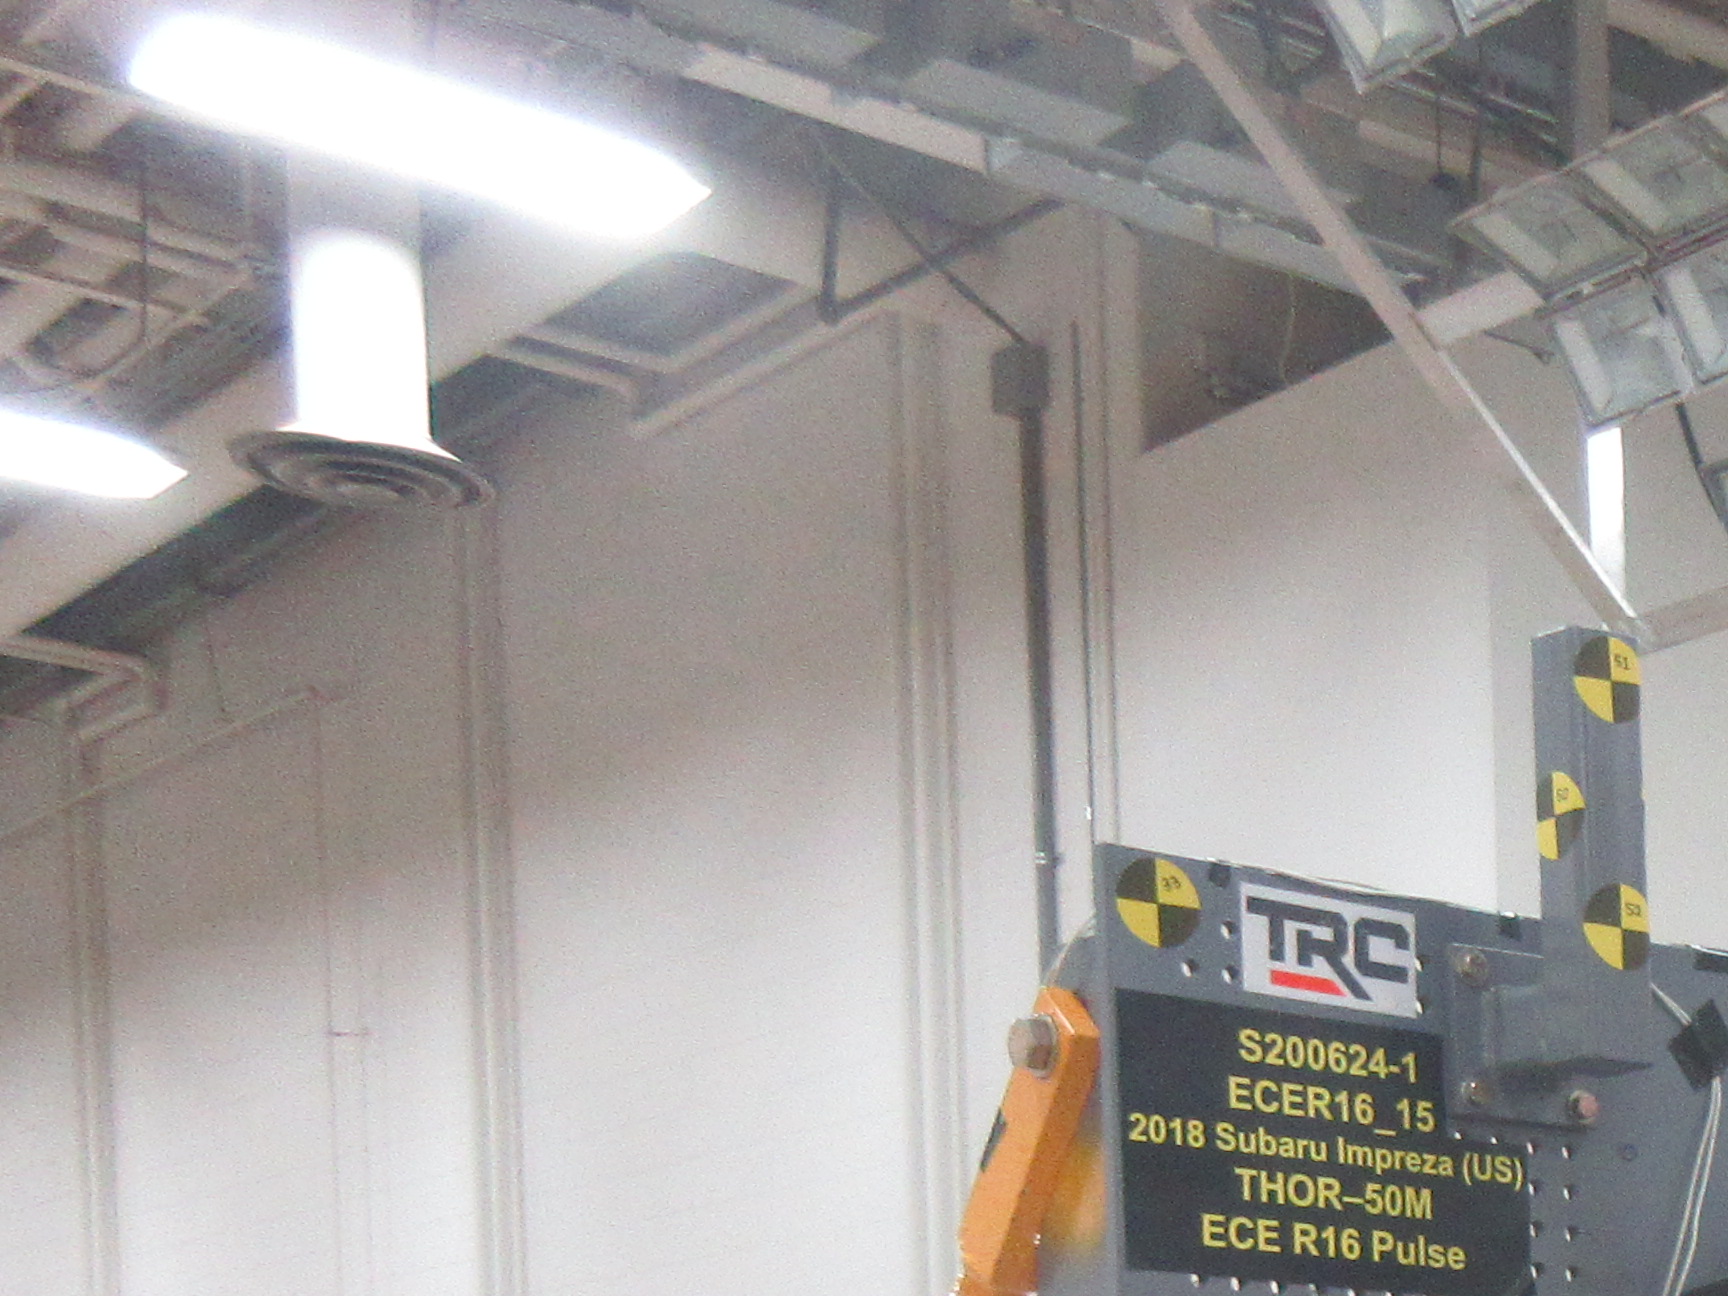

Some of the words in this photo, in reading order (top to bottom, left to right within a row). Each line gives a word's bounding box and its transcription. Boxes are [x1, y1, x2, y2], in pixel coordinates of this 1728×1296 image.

[1246, 894, 1411, 1002] TRC
[1237, 1027, 1418, 1084] S200624-1
[1227, 1074, 1437, 1137] ECER16_15
[1128, 1111, 1207, 1149] 2018
[1214, 1121, 1328, 1163] Subaru
[1337, 1136, 1456, 1178] Impreza
[1461, 1152, 1525, 1193] (US)
[1201, 1212, 1282, 1254] ECE
[1292, 1222, 1363, 1261] R16
[1371, 1229, 1468, 1271] Pulse
